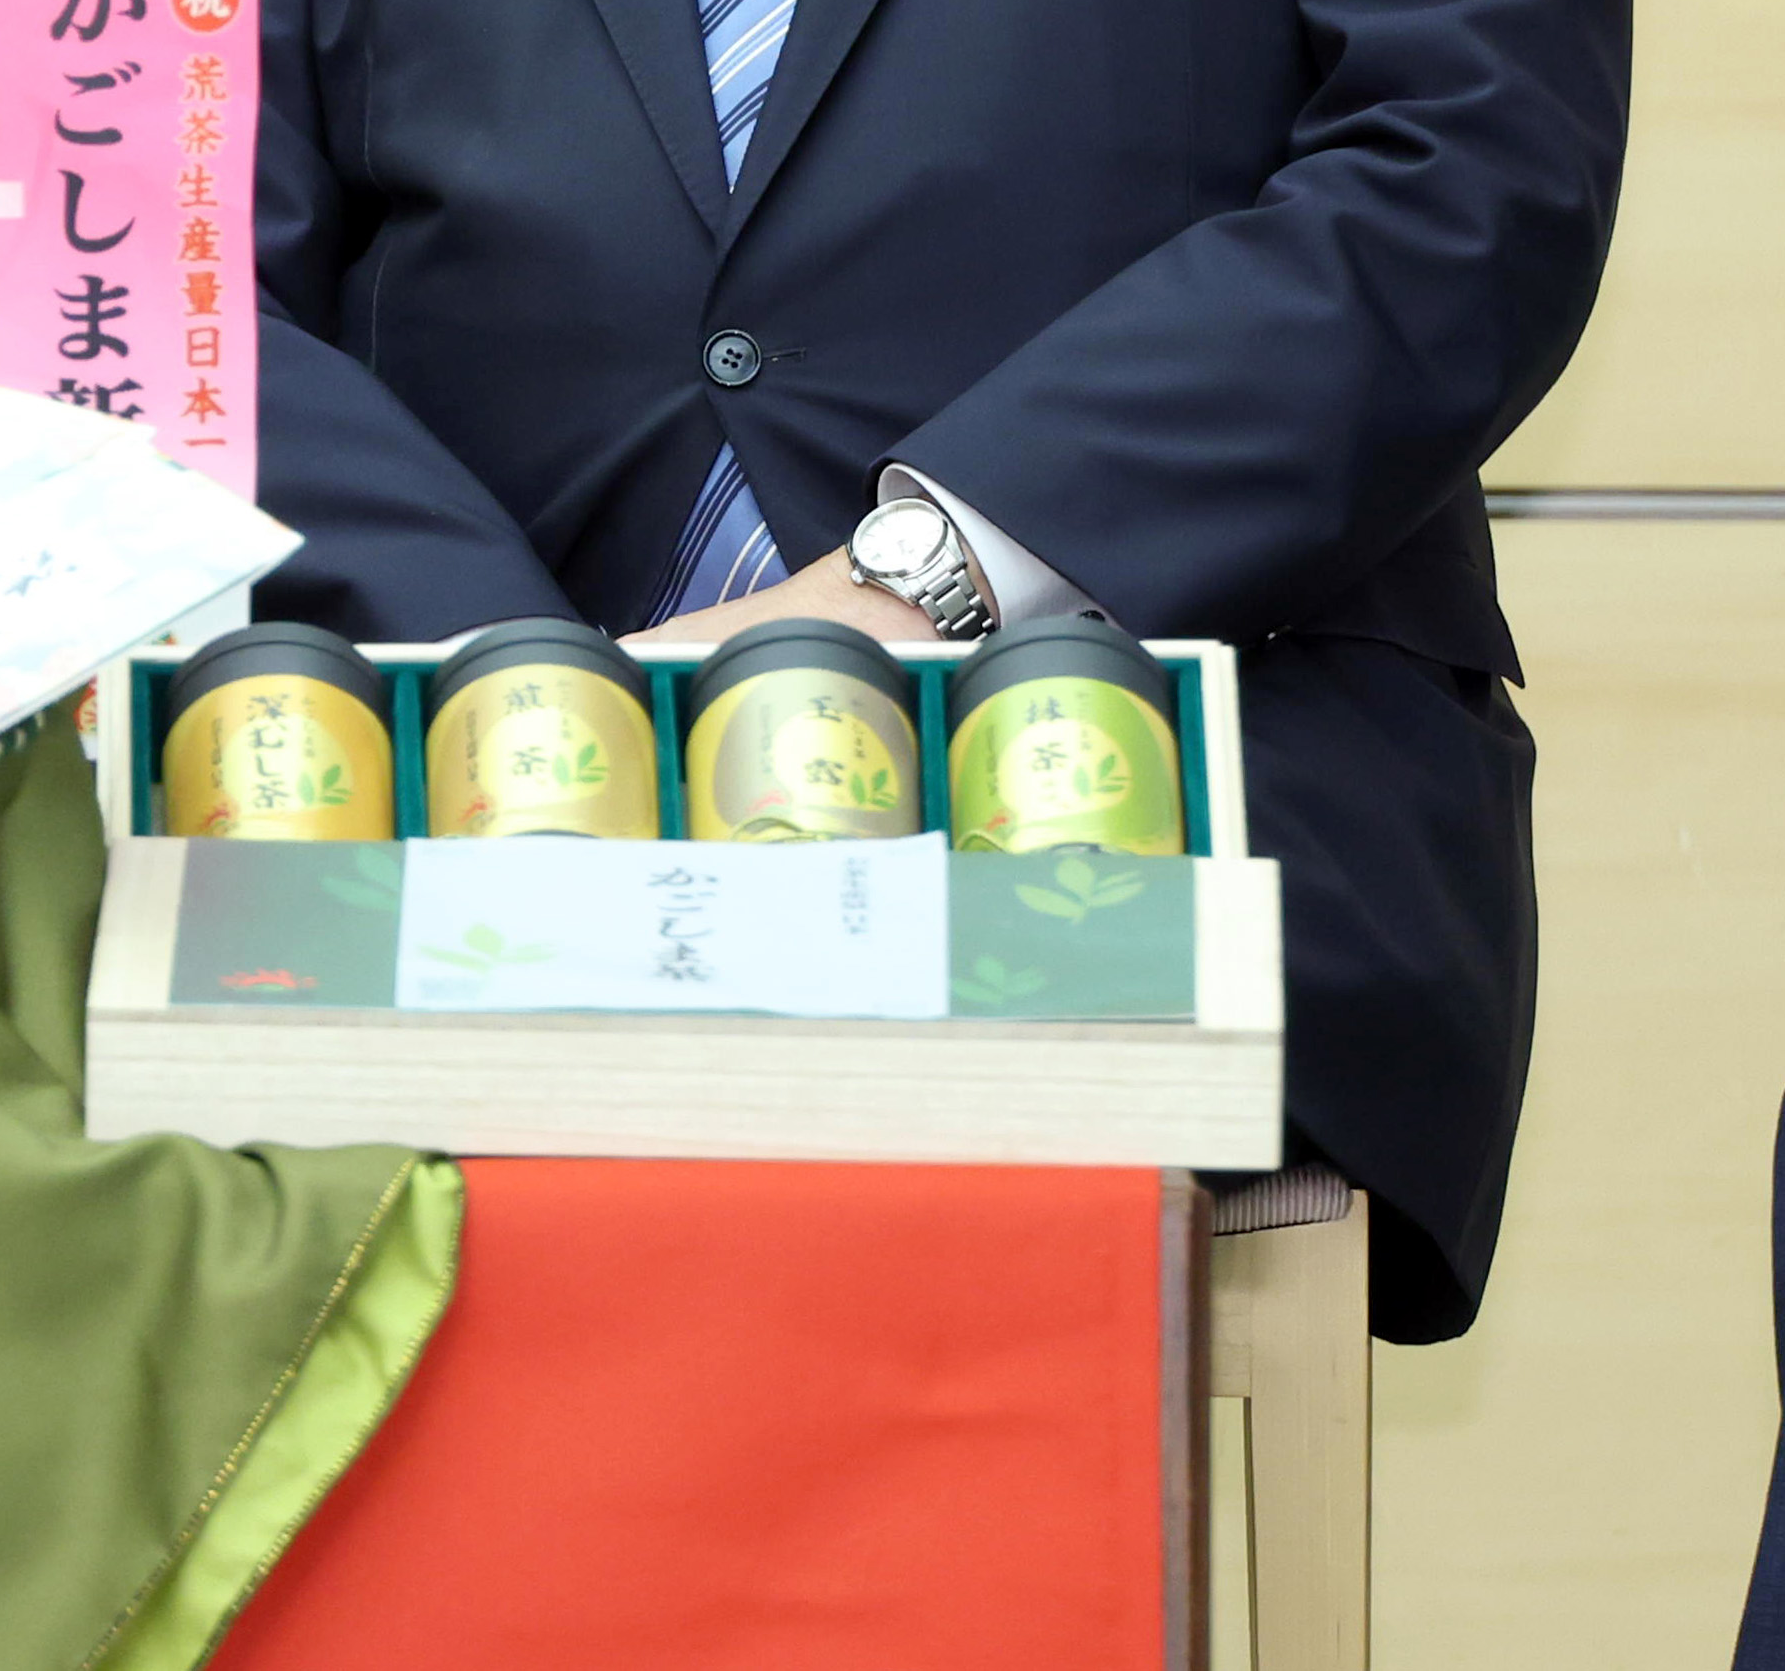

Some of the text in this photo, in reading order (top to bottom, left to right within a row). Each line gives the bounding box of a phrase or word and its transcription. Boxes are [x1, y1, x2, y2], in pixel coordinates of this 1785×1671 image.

[178, 57, 227, 448] 荒茶生産量日本一
